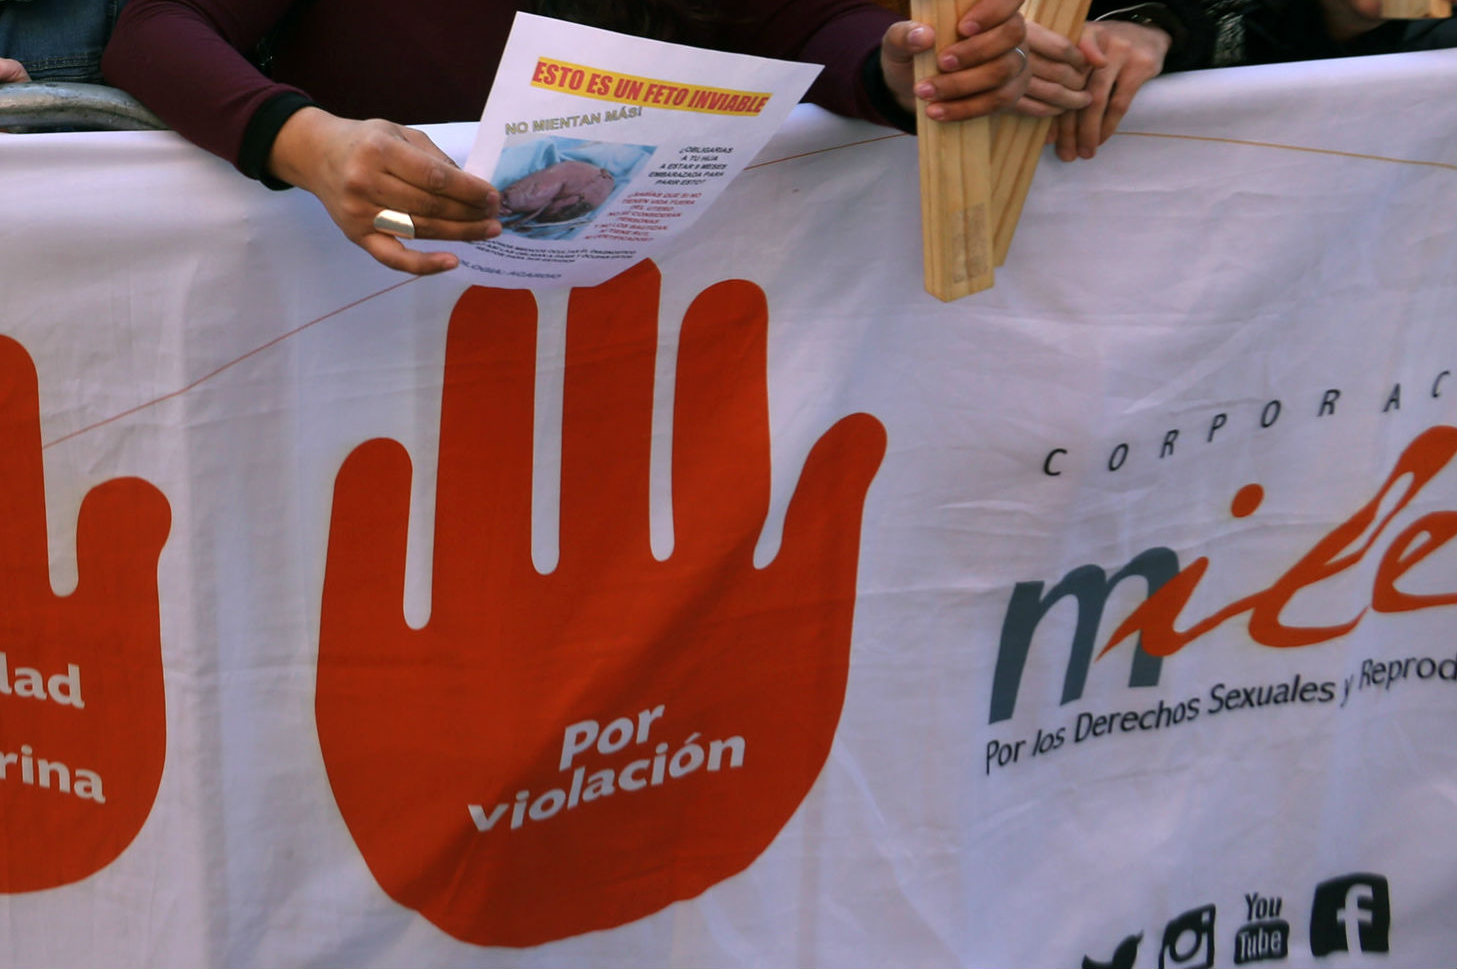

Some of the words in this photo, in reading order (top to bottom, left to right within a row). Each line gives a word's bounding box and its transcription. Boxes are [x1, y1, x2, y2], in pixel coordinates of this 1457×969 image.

[531, 61, 585, 91] ESTO
[586, 71, 614, 97] ES
[613, 78, 644, 102] UN
[643, 83, 689, 107] FETO
[688, 89, 770, 113] INVIABLE
[505, 122, 529, 136] NO
[532, 112, 601, 133] MIENTAN
[558, 704, 665, 771] Por
[986, 737, 1026, 776] Por
[1032, 727, 1066, 757] los
[1074, 694, 1201, 744] Derechos
[1208, 674, 1336, 715] Sexuales
[1341, 675, 1355, 708] y
[468, 733, 746, 832] violación
[1245, 892, 1282, 921] You
[1239, 929, 1282, 958] Tube
